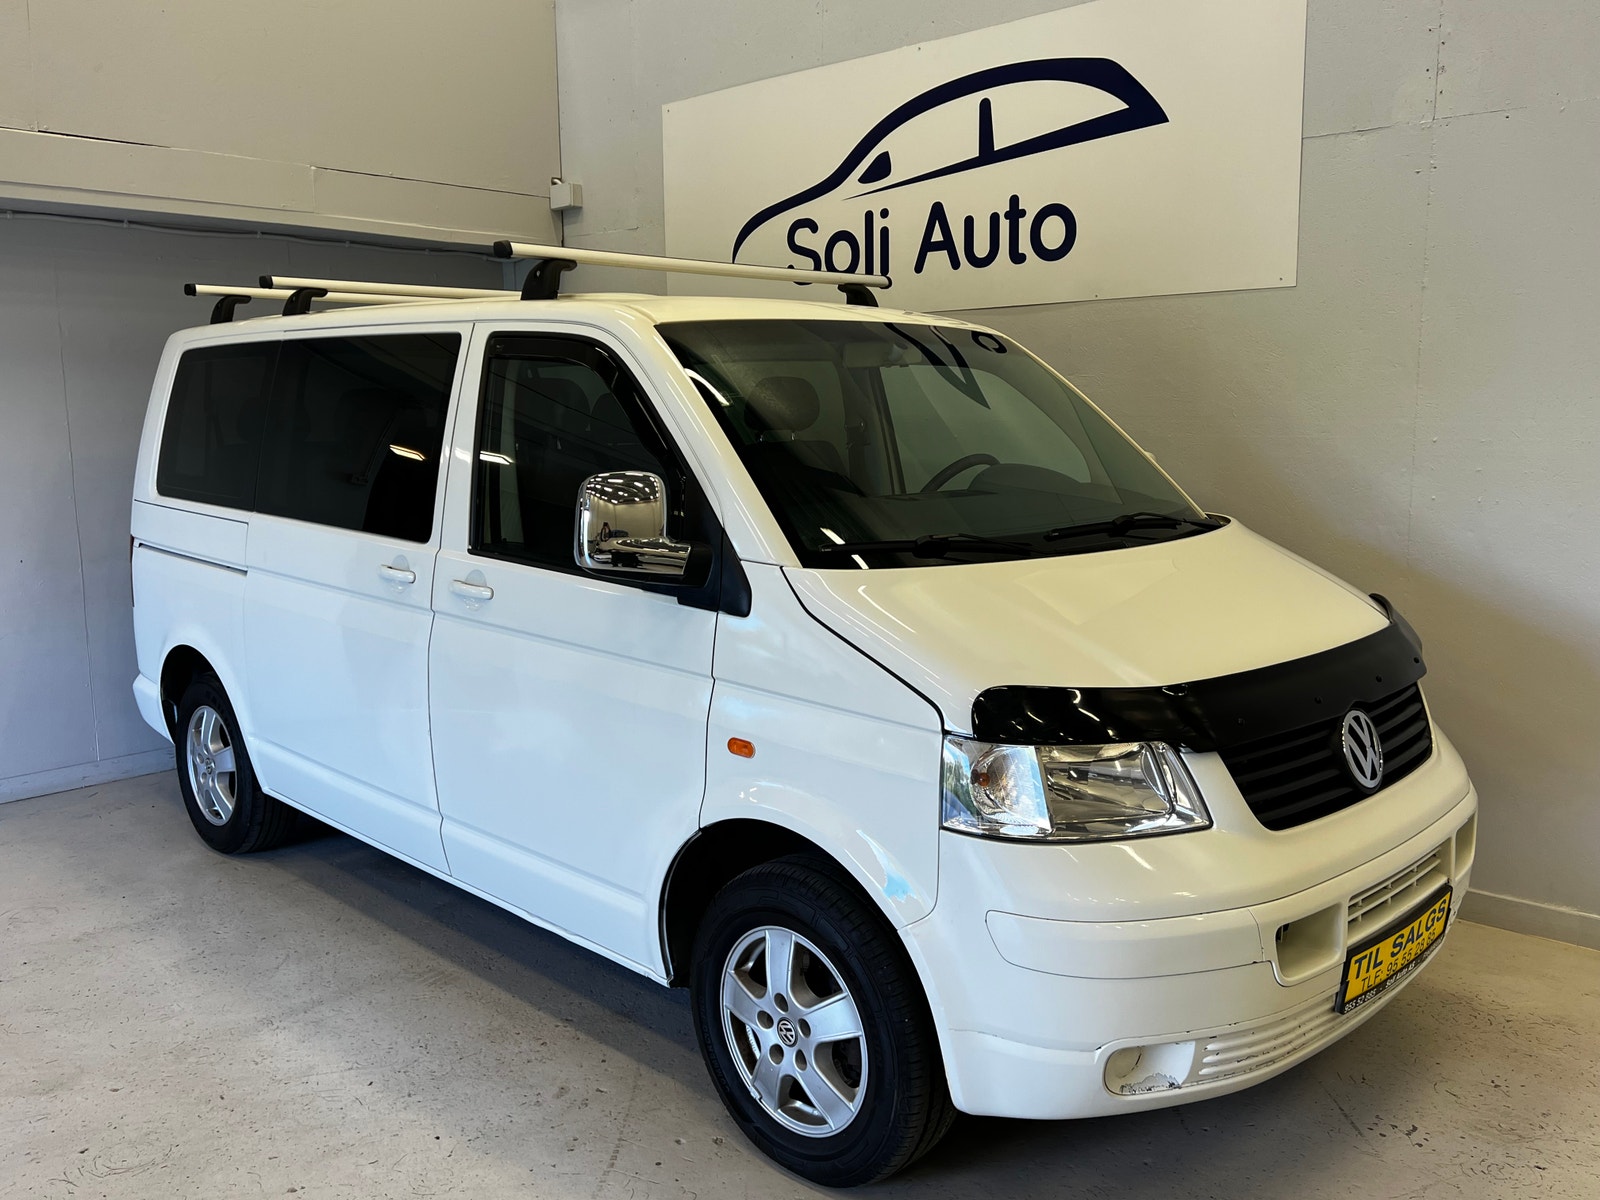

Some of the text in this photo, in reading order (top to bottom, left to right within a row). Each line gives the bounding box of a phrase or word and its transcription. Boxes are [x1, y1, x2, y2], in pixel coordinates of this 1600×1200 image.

[787, 194, 1077, 285] Soli Auto
[1354, 947, 1383, 980] TIL
[1390, 898, 1447, 958] SALGS
[1386, 957, 1399, 978] 95
[1400, 948, 1413, 967] 55
